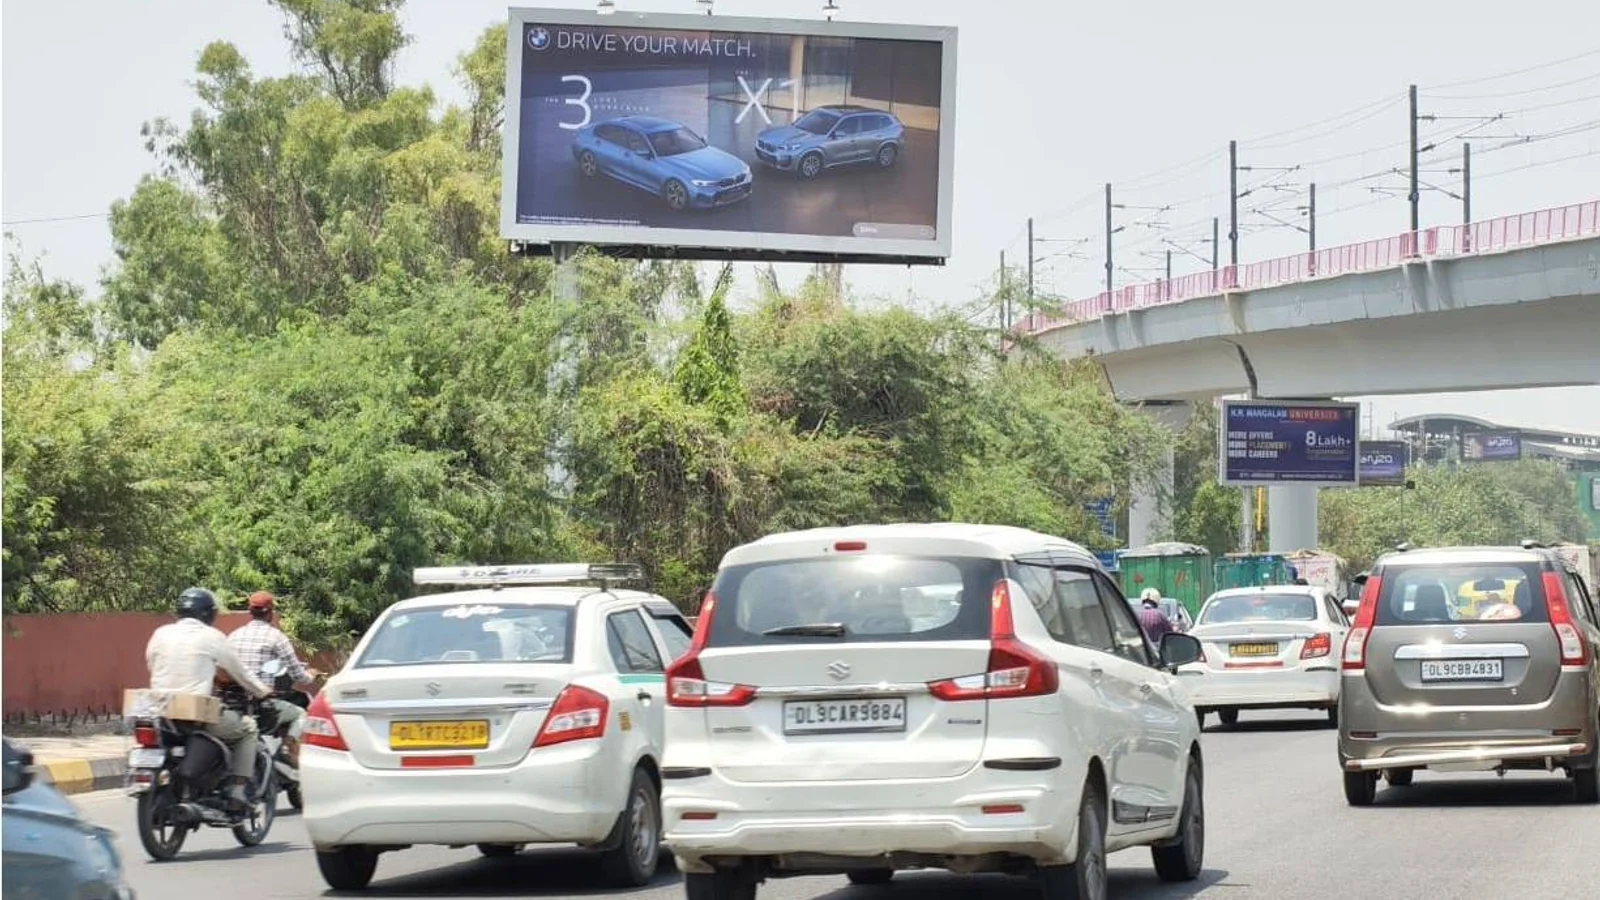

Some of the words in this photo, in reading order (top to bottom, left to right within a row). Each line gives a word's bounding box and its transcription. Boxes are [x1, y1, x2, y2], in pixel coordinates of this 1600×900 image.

[557, 31, 617, 51] DRIVE
[620, 34, 677, 54] YOUR
[683, 38, 757, 58] MATCH.
[558, 75, 592, 130] 3
[735, 75, 800, 125] X1
[1305, 430, 1317, 446] 8
[795, 703, 903, 724] DL9CAR9884
